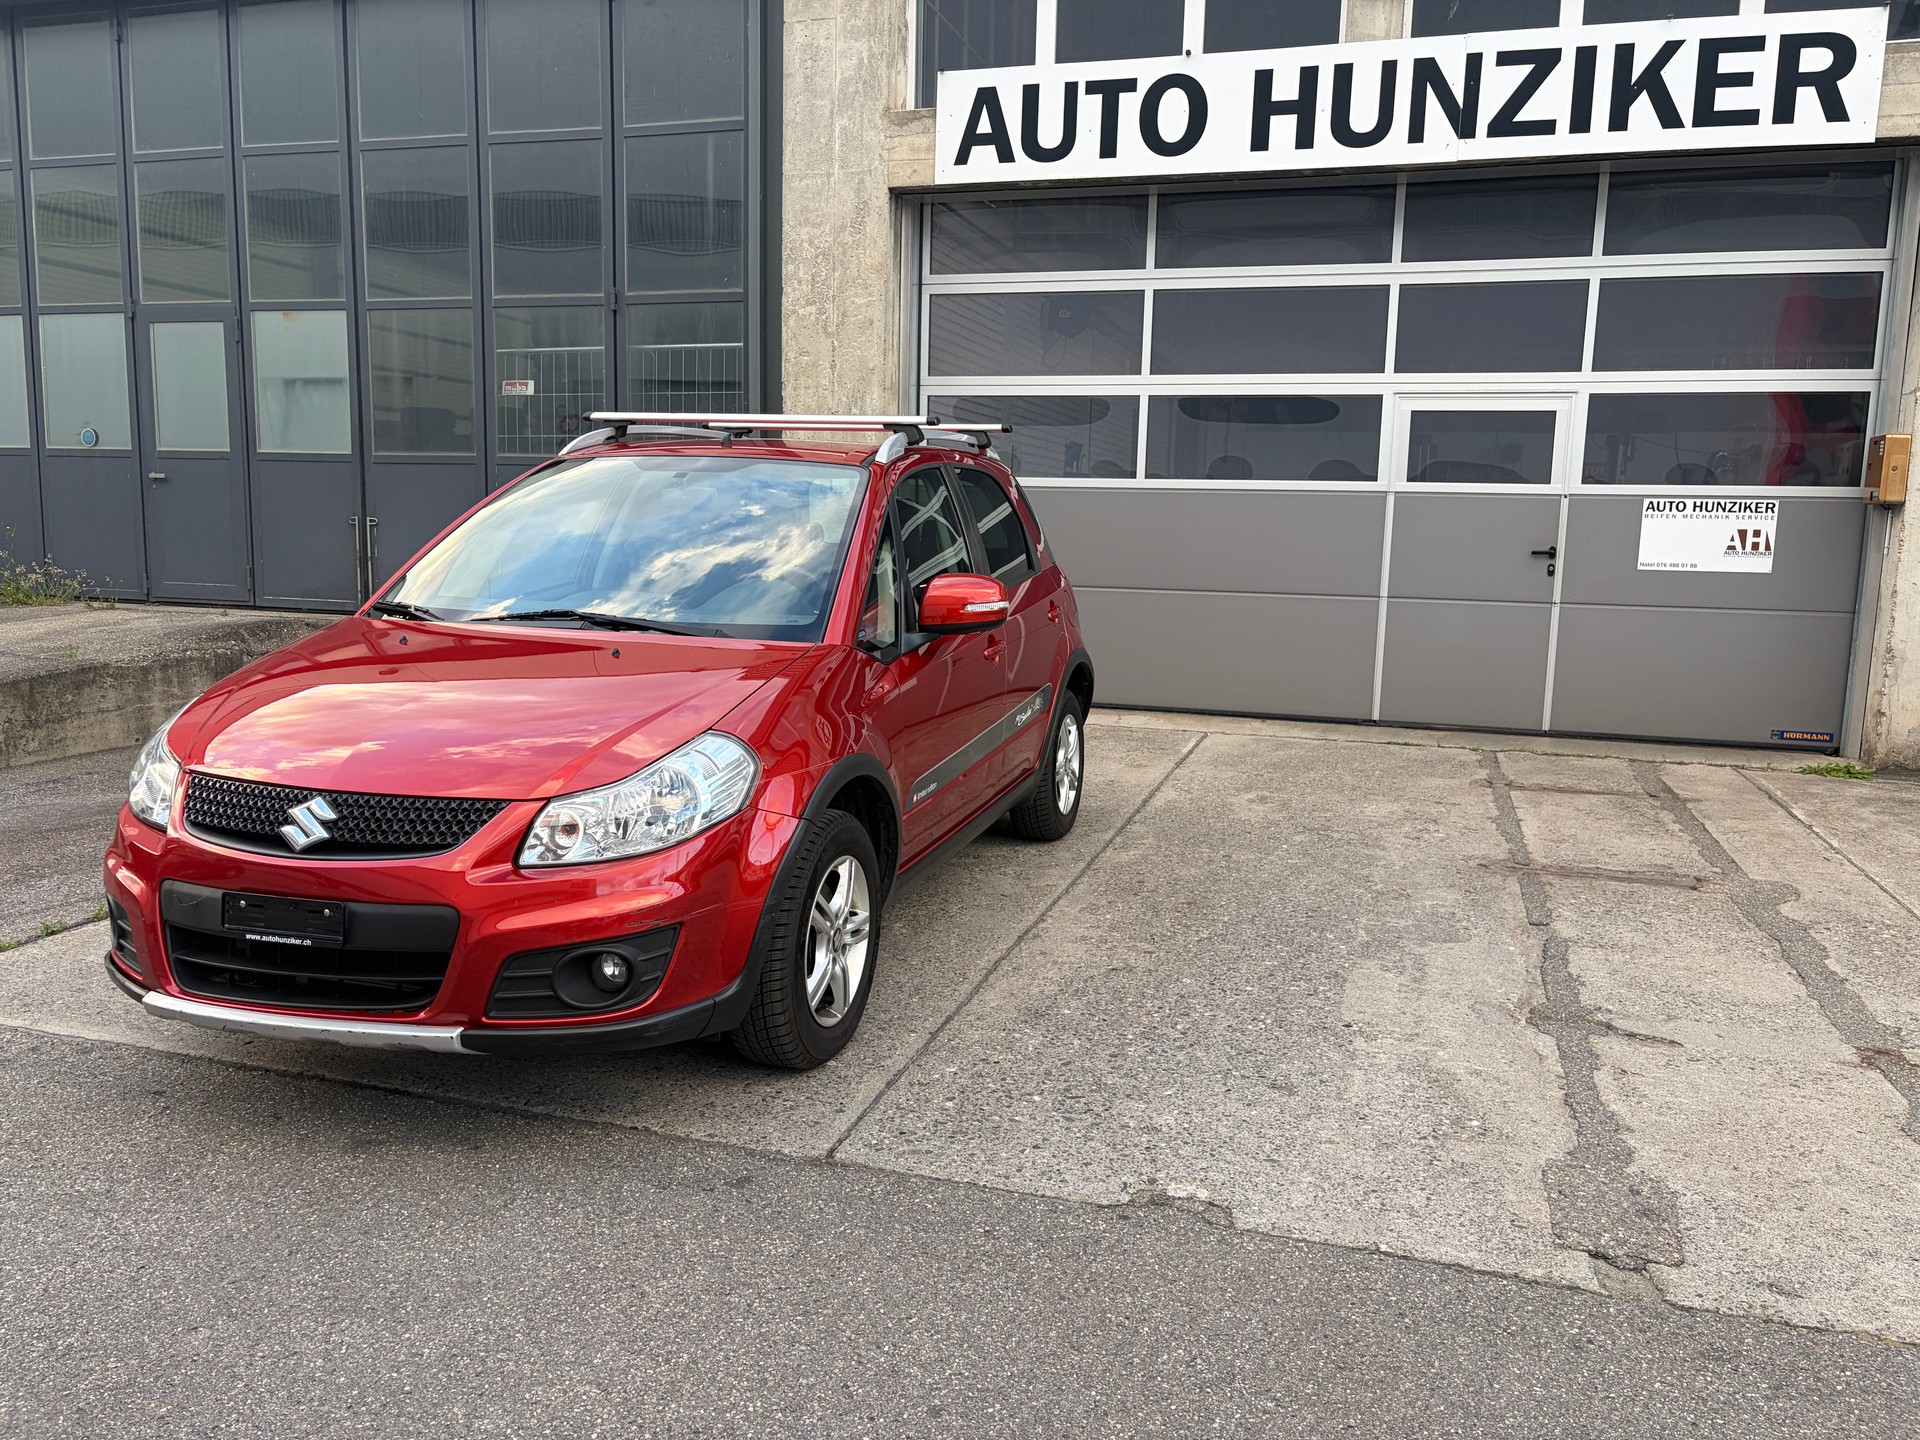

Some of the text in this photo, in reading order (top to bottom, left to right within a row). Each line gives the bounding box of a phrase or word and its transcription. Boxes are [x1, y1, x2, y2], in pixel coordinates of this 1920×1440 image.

[954, 32, 1857, 166] AUTO HUNZIKER
[1645, 501, 1777, 514] AUTO HUNZIKER
[245, 934, 312, 946] www.autohunziker.ch
